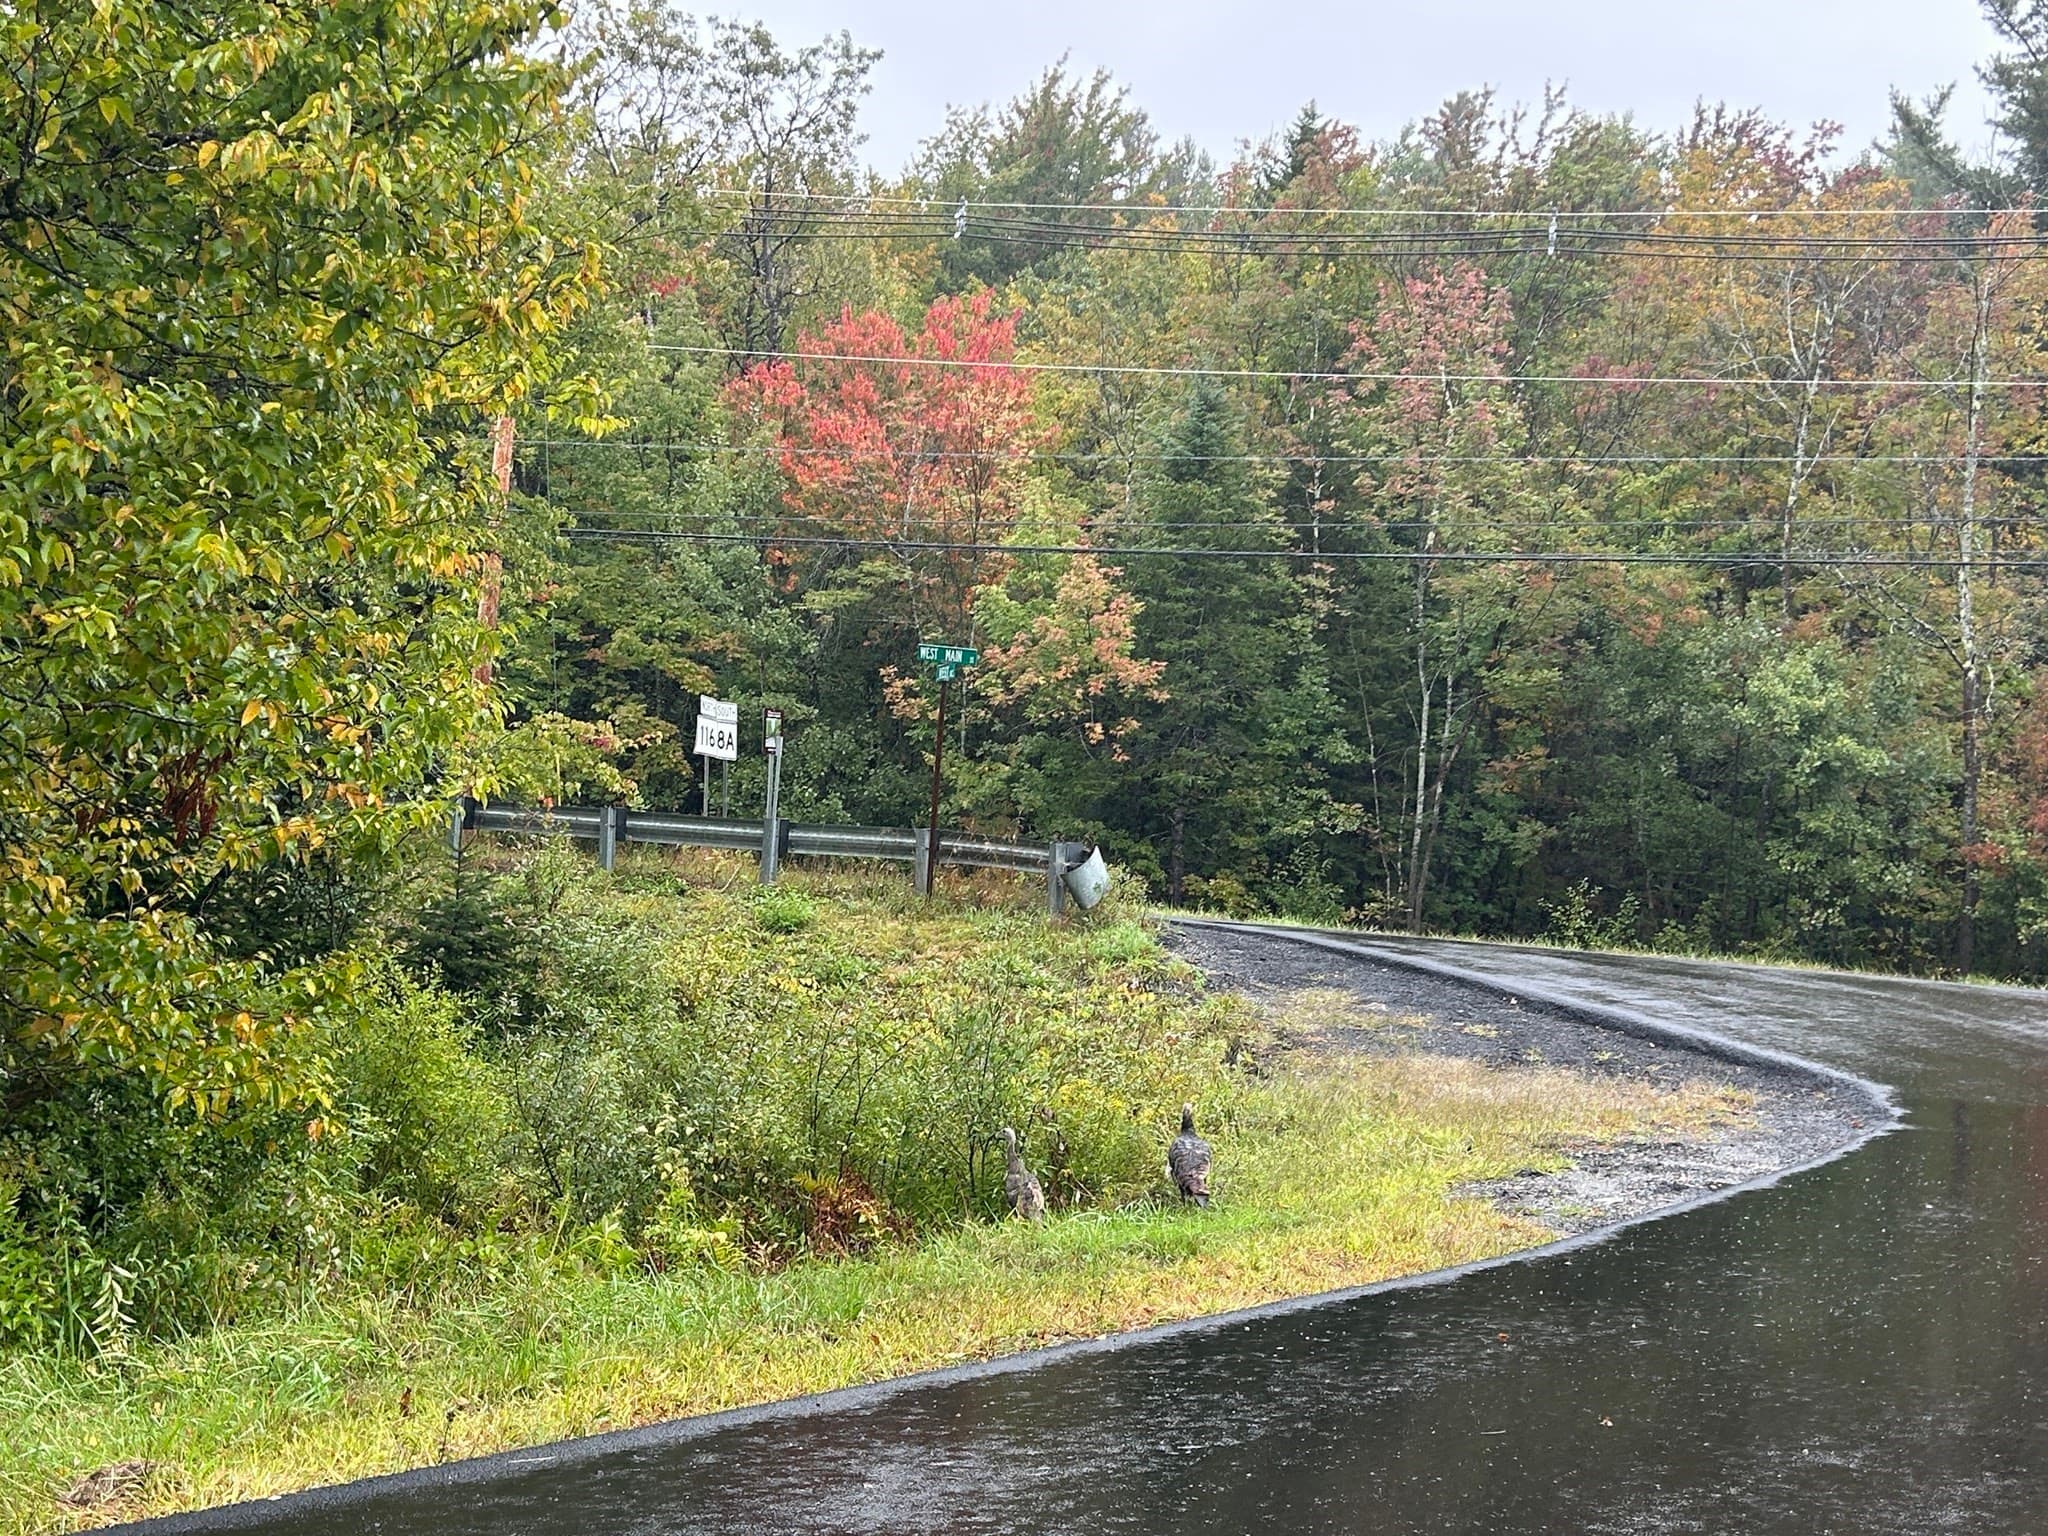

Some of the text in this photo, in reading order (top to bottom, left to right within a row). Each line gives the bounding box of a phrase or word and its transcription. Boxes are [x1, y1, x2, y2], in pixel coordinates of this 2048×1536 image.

[920, 646, 938, 660] WEST
[945, 649, 963, 663] MAIN
[717, 704, 736, 717] SOUTH
